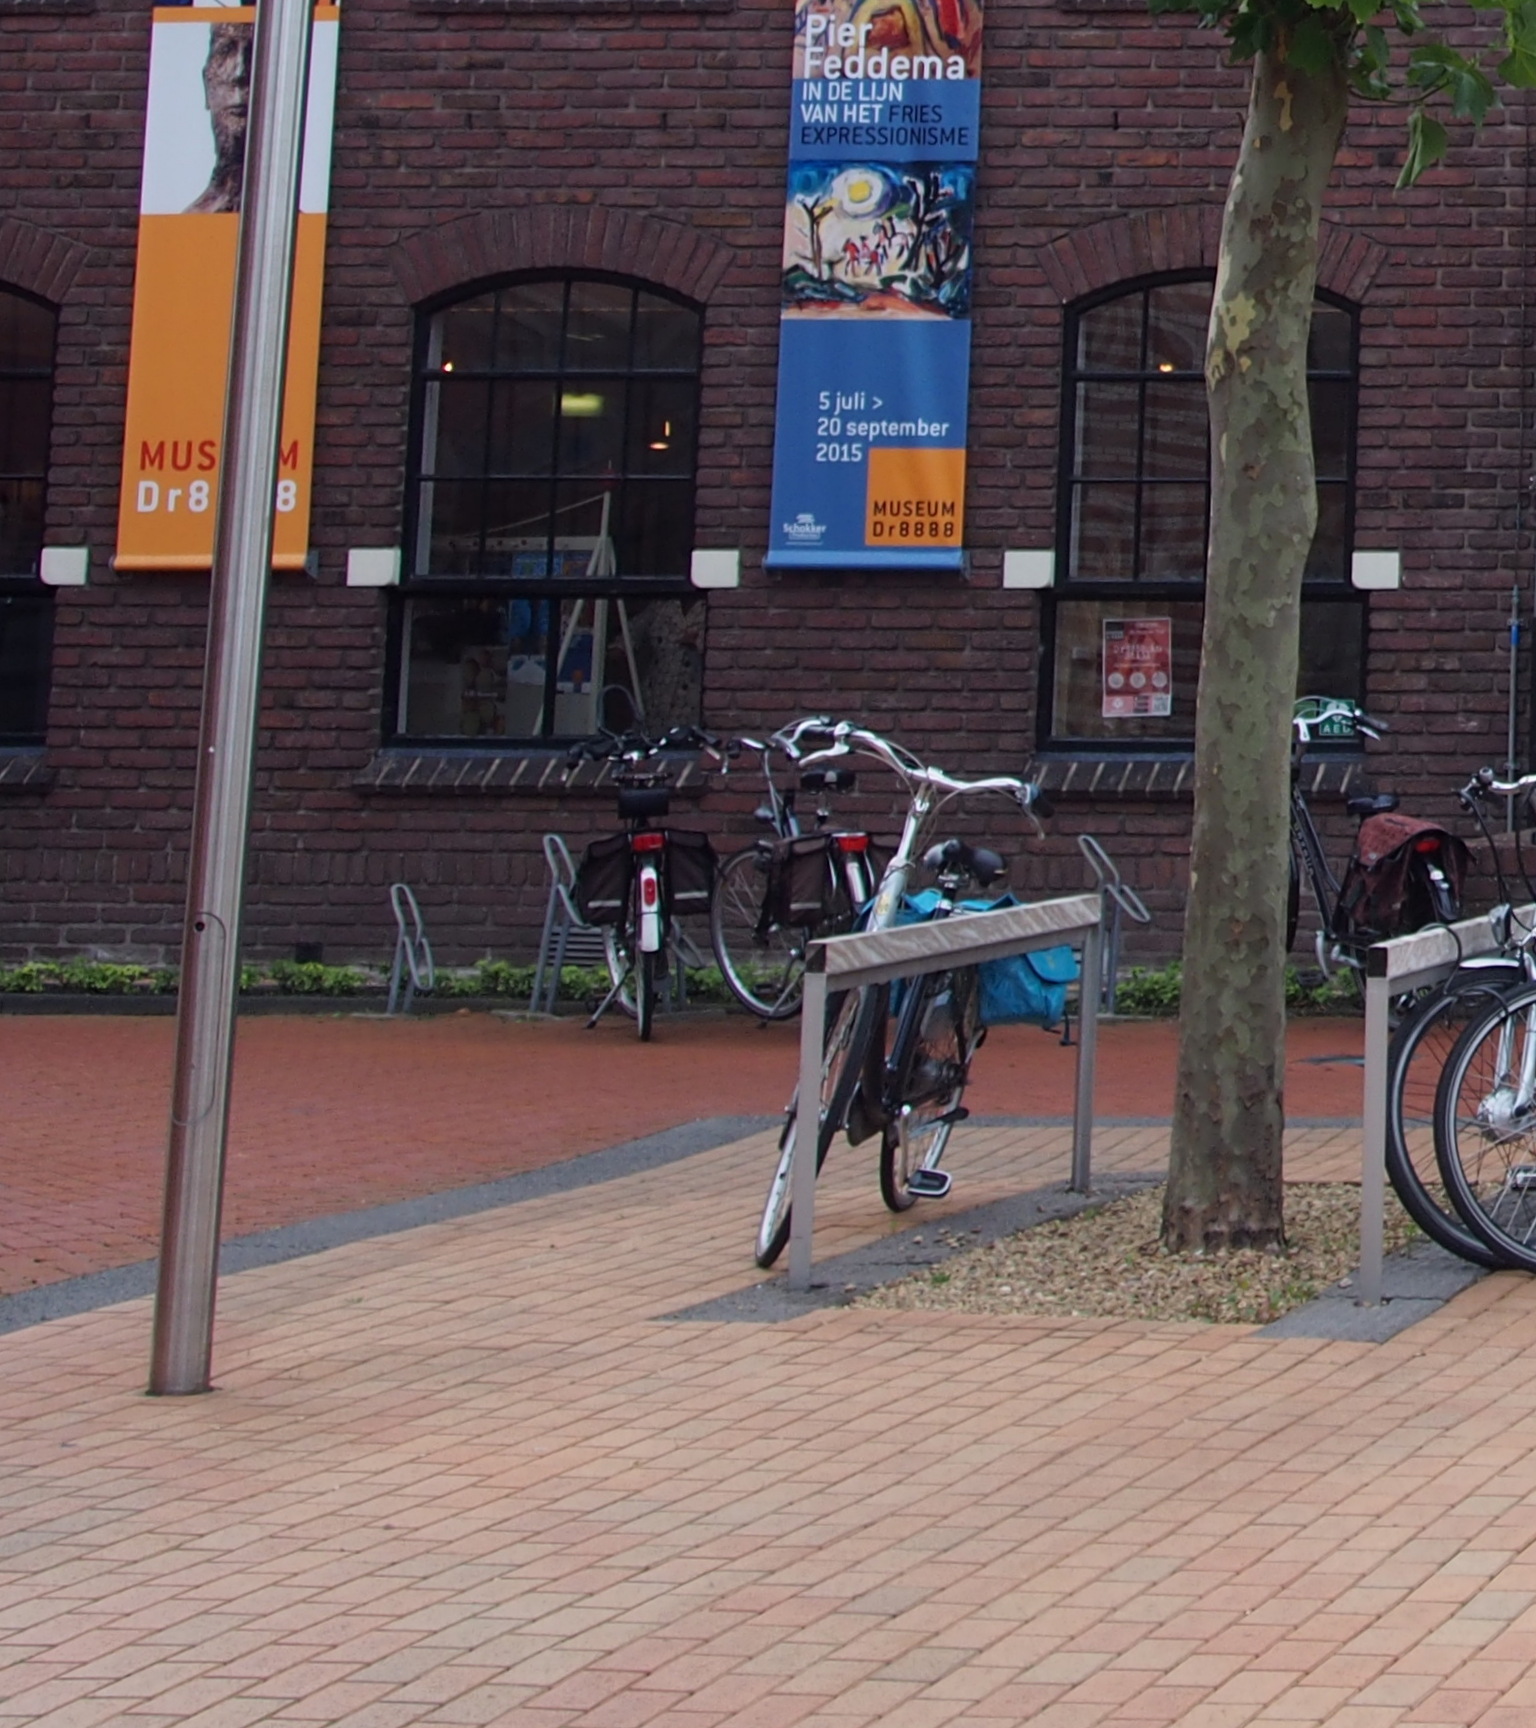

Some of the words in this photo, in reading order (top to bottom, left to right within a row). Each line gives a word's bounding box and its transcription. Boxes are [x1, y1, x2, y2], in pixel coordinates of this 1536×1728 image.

[804, 14, 873, 47] Pier
[803, 46, 965, 80] Feddema
[803, 81, 822, 101] IN
[828, 81, 852, 101] DE
[859, 81, 903, 101] LIJN
[800, 104, 838, 123] VAN
[843, 104, 883, 123] HET
[888, 105, 943, 123] FRIES
[801, 126, 970, 146] EXPRESSIONISME
[818, 391, 830, 410] 5
[834, 391, 865, 415] juli
[817, 417, 841, 437] 20
[846, 418, 949, 442] september
[140, 440, 299, 471] MUSM
[816, 443, 863, 462] 2015
[136, 479, 297, 512] Dr88
[873, 500, 956, 517] MUSEUM
[872, 521, 955, 538] Dr8888
